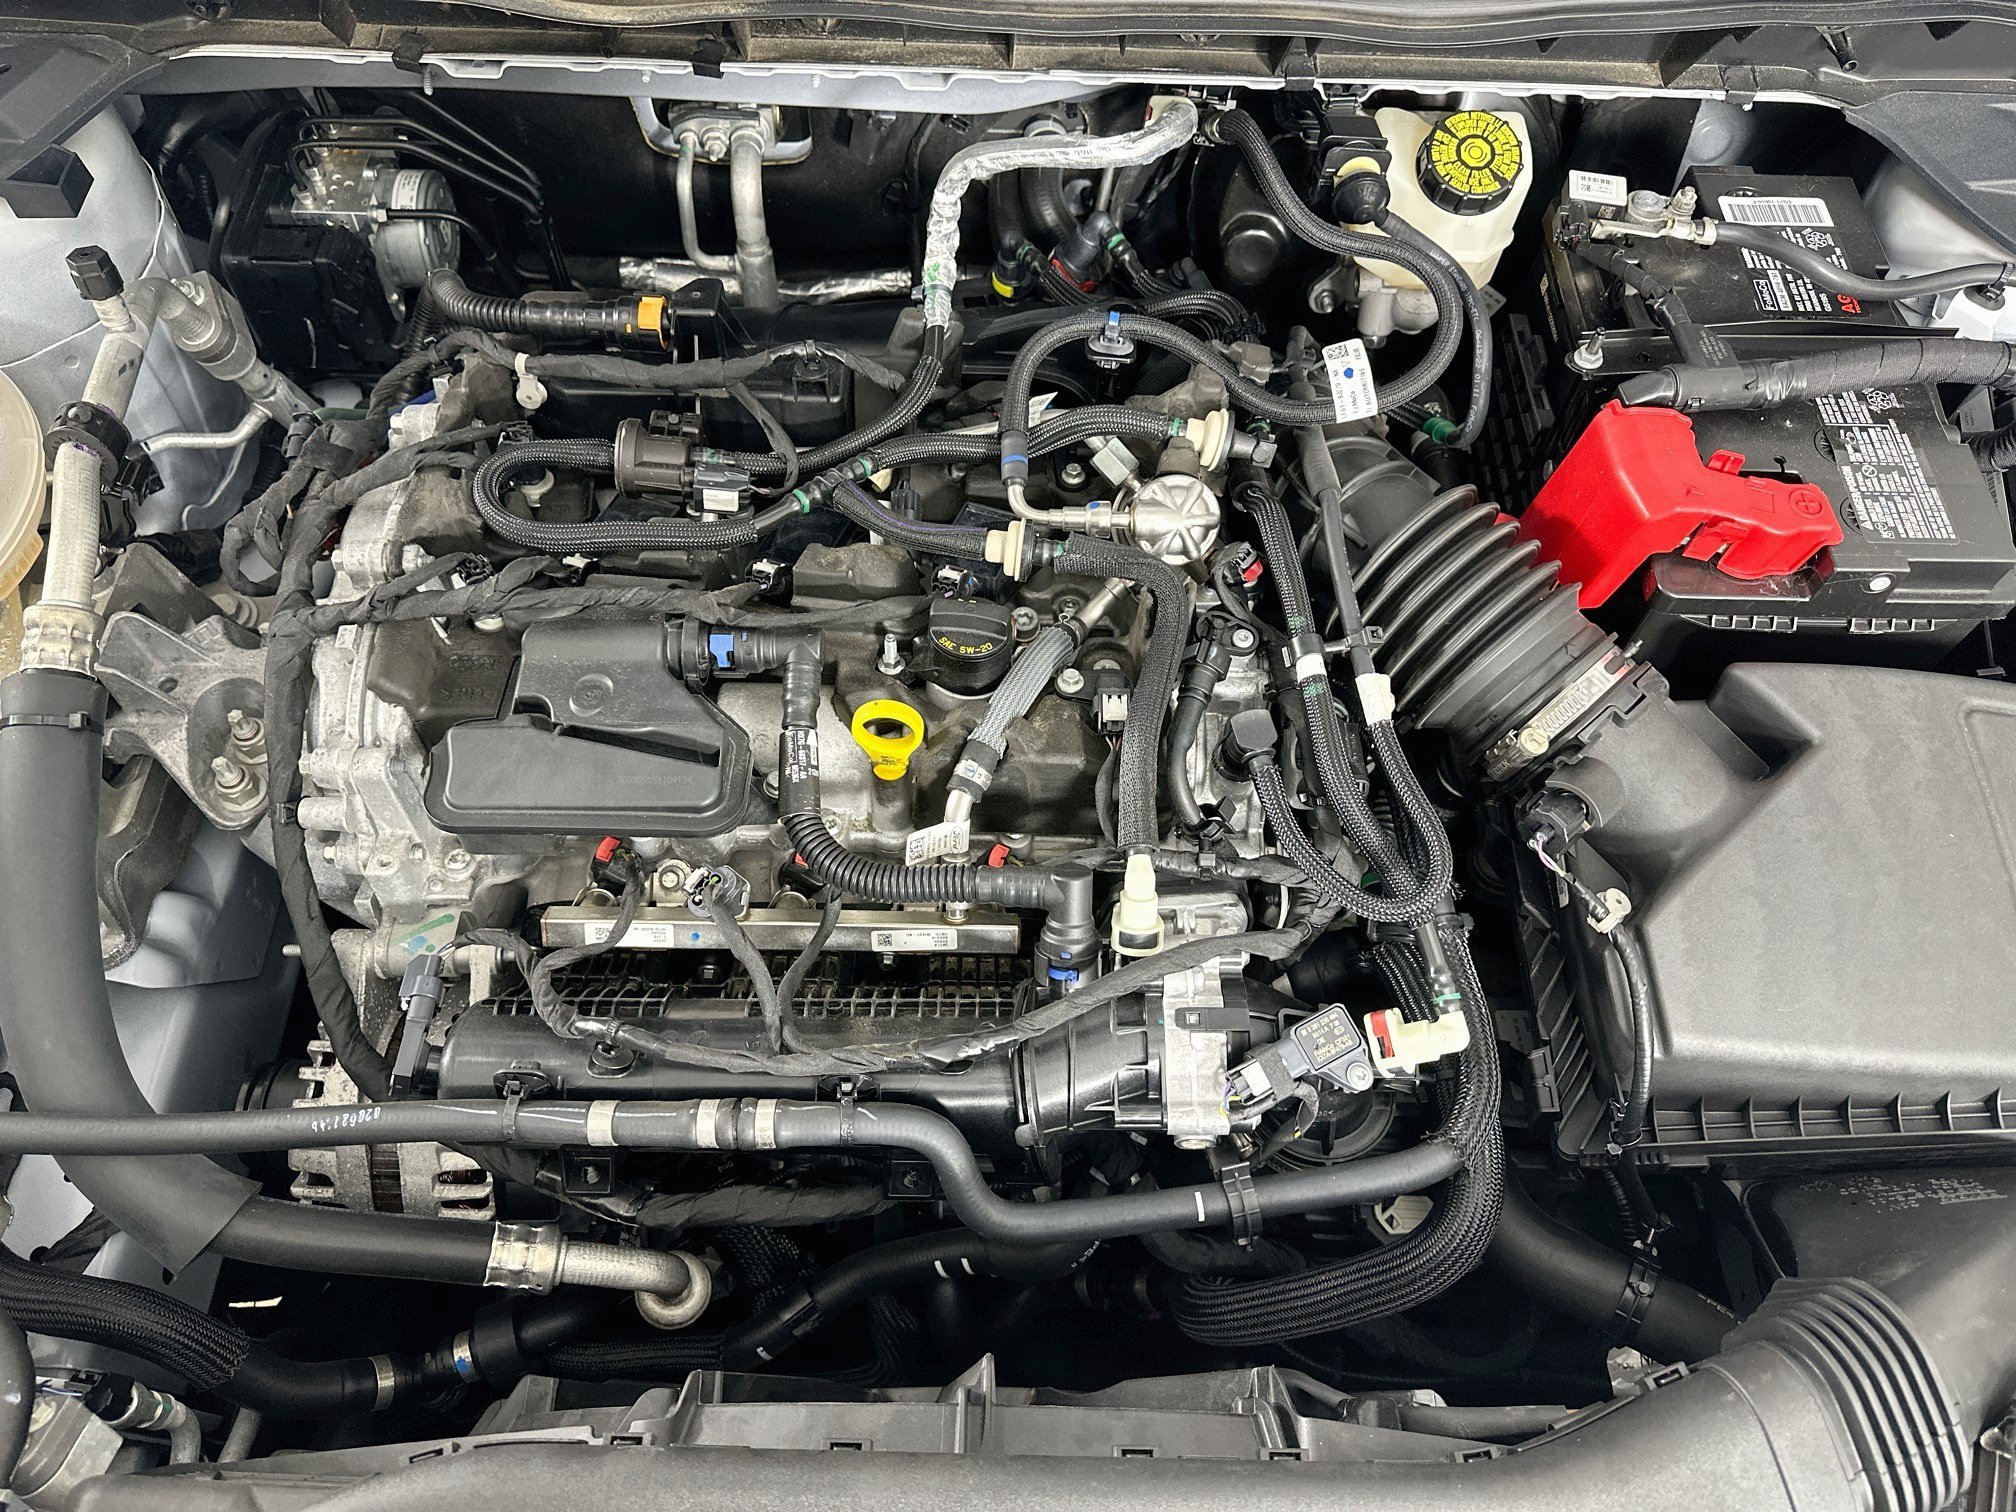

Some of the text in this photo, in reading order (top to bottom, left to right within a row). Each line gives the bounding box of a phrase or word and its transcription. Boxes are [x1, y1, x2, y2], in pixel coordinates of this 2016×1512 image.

[1493, 119, 1504, 128] LE
[1431, 145, 1440, 162] FLUID
[1434, 162, 1447, 177] FROM
[1452, 161, 1471, 177] CLEAN
[1471, 167, 1492, 178] FILLER
[1448, 178, 1470, 192] SEALED
[1468, 178, 1480, 186] USE
[1480, 175, 1496, 186] ONLY
[1756, 281, 1776, 309] FoMoCo
[1359, 368, 1372, 405] AUTOMOTIVE
[1841, 465, 1868, 520] DANGER/POISON
[939, 636, 993, 654] SAE 5W-20
[785, 732, 794, 762] FoMoCo
[1314, 1044, 1334, 1057] FoMoCo
